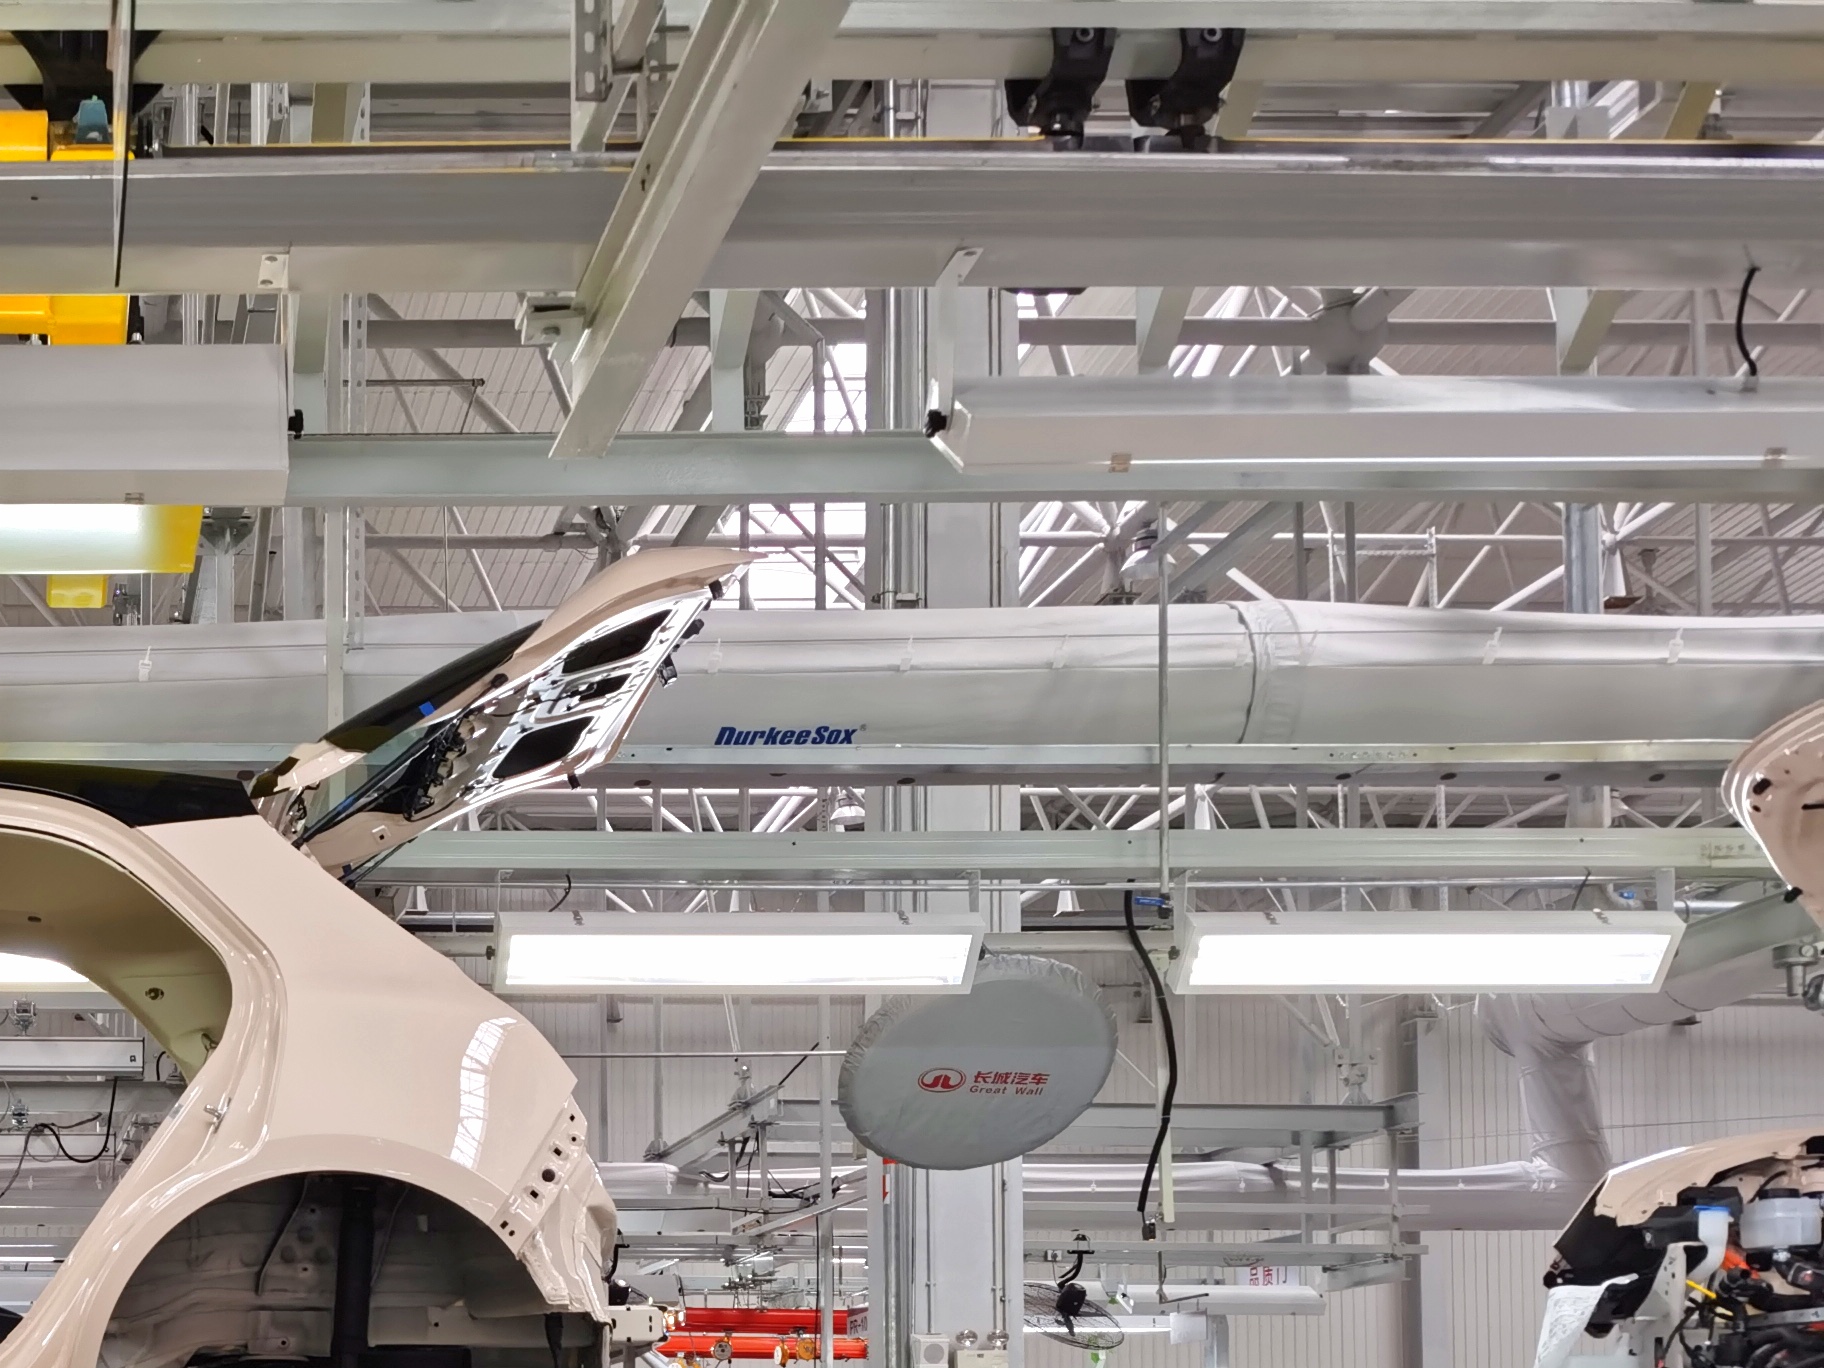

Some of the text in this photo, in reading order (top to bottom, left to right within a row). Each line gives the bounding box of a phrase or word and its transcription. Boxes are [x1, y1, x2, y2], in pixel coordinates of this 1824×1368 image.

[973, 1071, 1050, 1085] 长城汽车
[969, 1085, 1044, 1096] Great Wall
